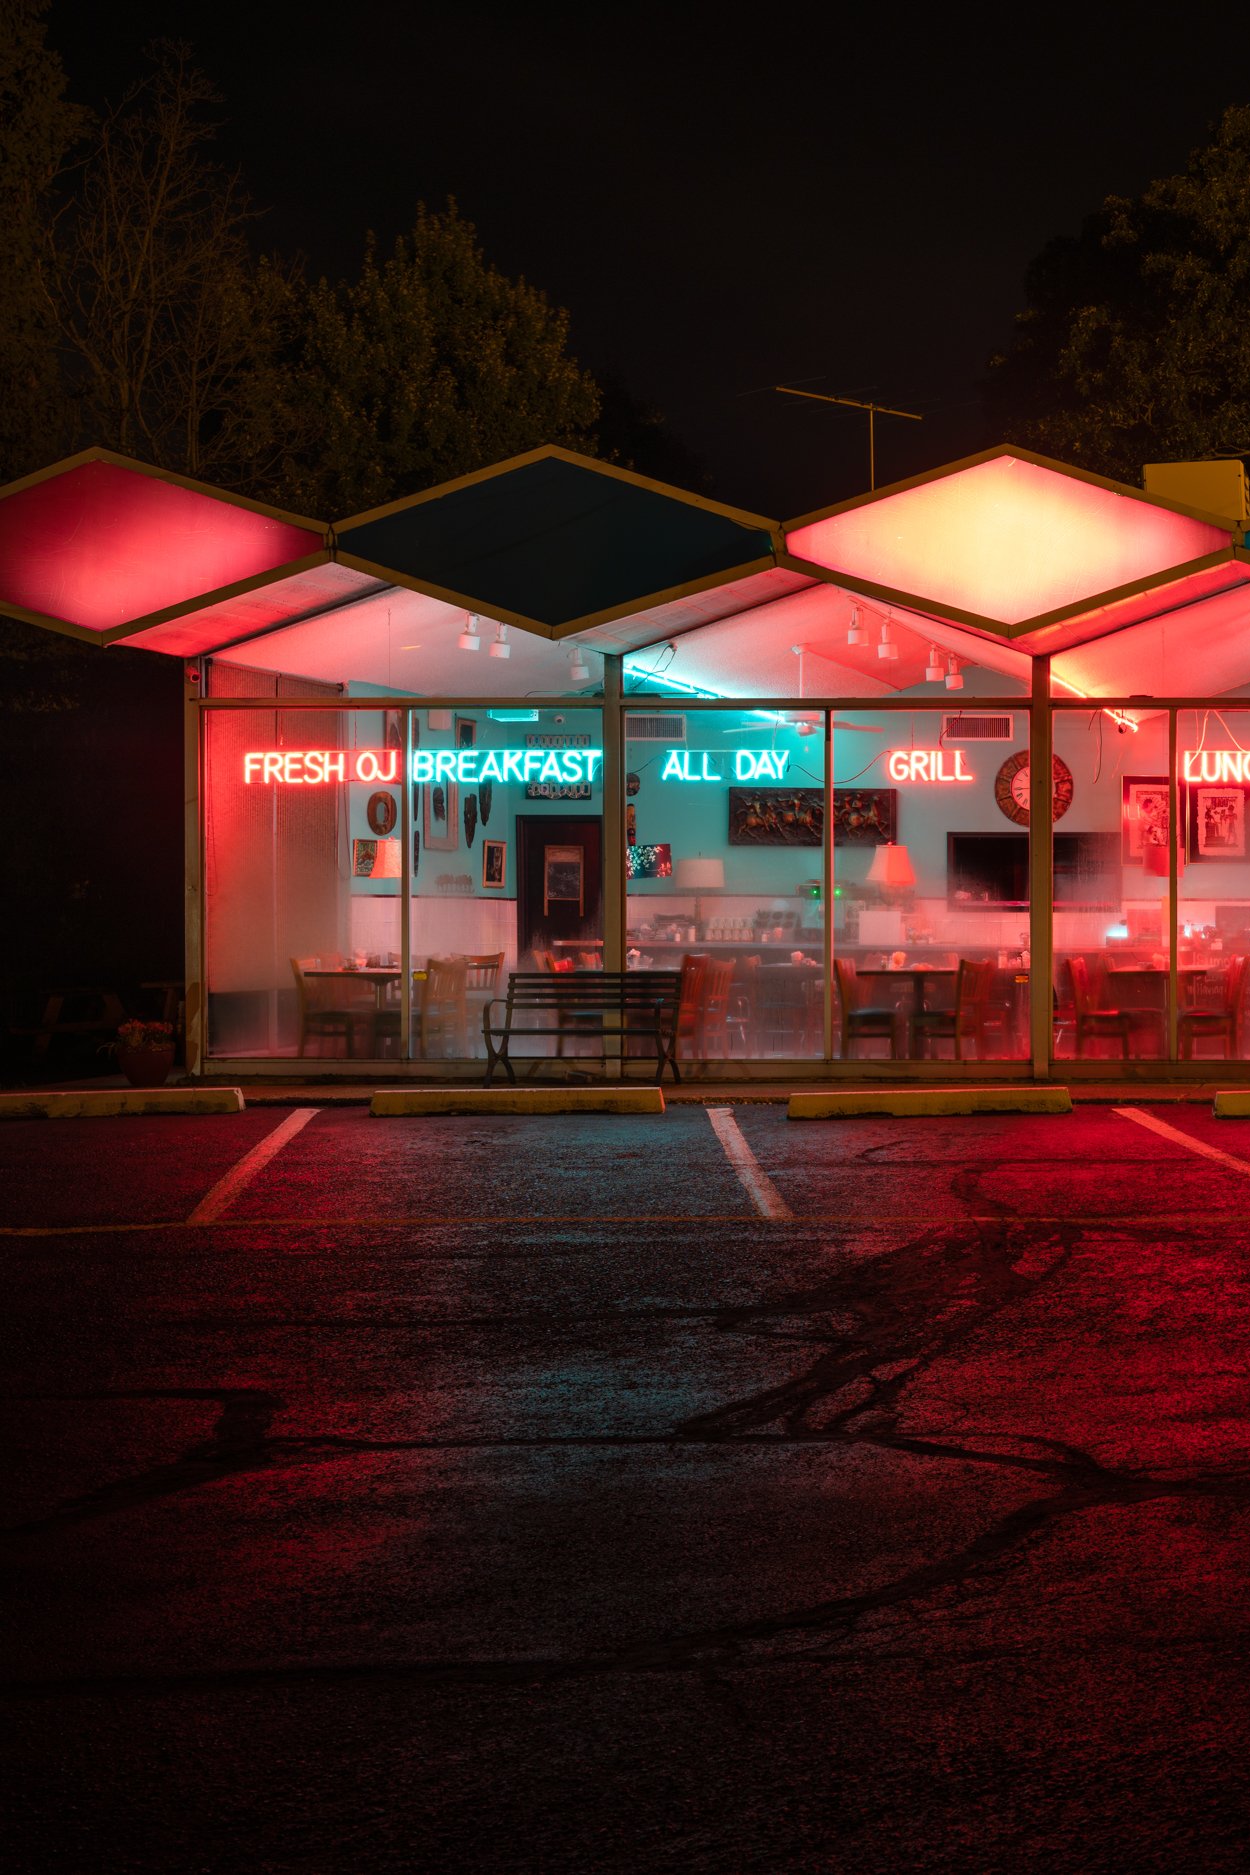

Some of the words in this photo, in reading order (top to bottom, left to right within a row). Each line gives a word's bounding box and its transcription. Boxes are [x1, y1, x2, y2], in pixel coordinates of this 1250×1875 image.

[244, 752, 344, 784] FRESH
[356, 751, 396, 781] OJ
[413, 750, 602, 782] BREAKFAST
[662, 750, 721, 780] ALL
[736, 750, 788, 780] DAY
[889, 751, 973, 781] GRILL
